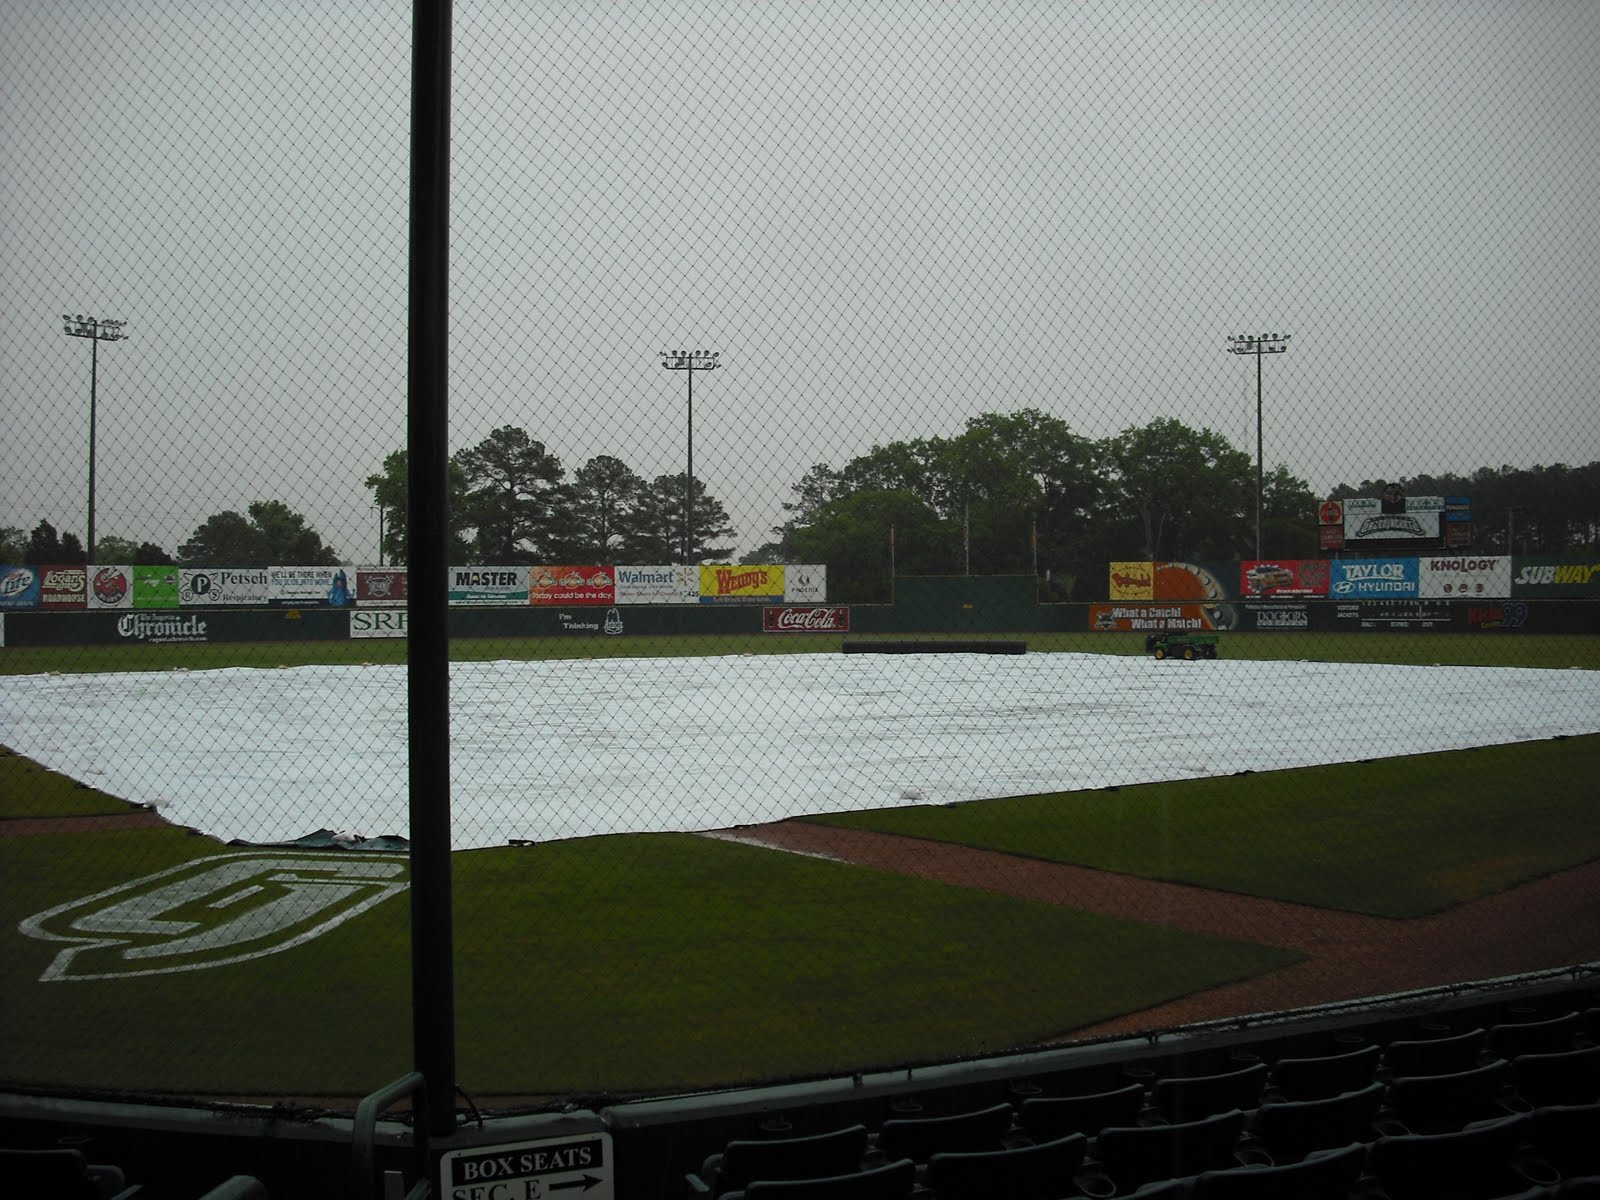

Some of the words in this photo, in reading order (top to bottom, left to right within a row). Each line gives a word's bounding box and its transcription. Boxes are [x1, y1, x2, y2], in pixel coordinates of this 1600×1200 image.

[1430, 557, 1496, 572] KNOLOGY
[221, 572, 268, 585] Petsch
[618, 571, 674, 583] Walmart
[1342, 564, 1404, 580] TAYLOR
[1515, 565, 1600, 585] SUBWAY
[456, 572, 518, 586] MASTER
[1358, 582, 1415, 591] HYUNDAI
[43, 594, 86, 603] ROADHOUSE
[222, 594, 267, 602] Respiratory
[532, 592, 552, 600] Today
[598, 592, 613, 600] day.
[1113, 607, 1139, 618] What
[1140, 610, 1147, 618] a
[1149, 607, 1182, 618] Catch!
[117, 613, 208, 639] Chronicle
[1131, 619, 1158, 629] What
[1167, 618, 1202, 629] Match!
[463, 1157, 515, 1181] BOX
[520, 1147, 592, 1173] SEATS
[524, 1179, 542, 1200] E
